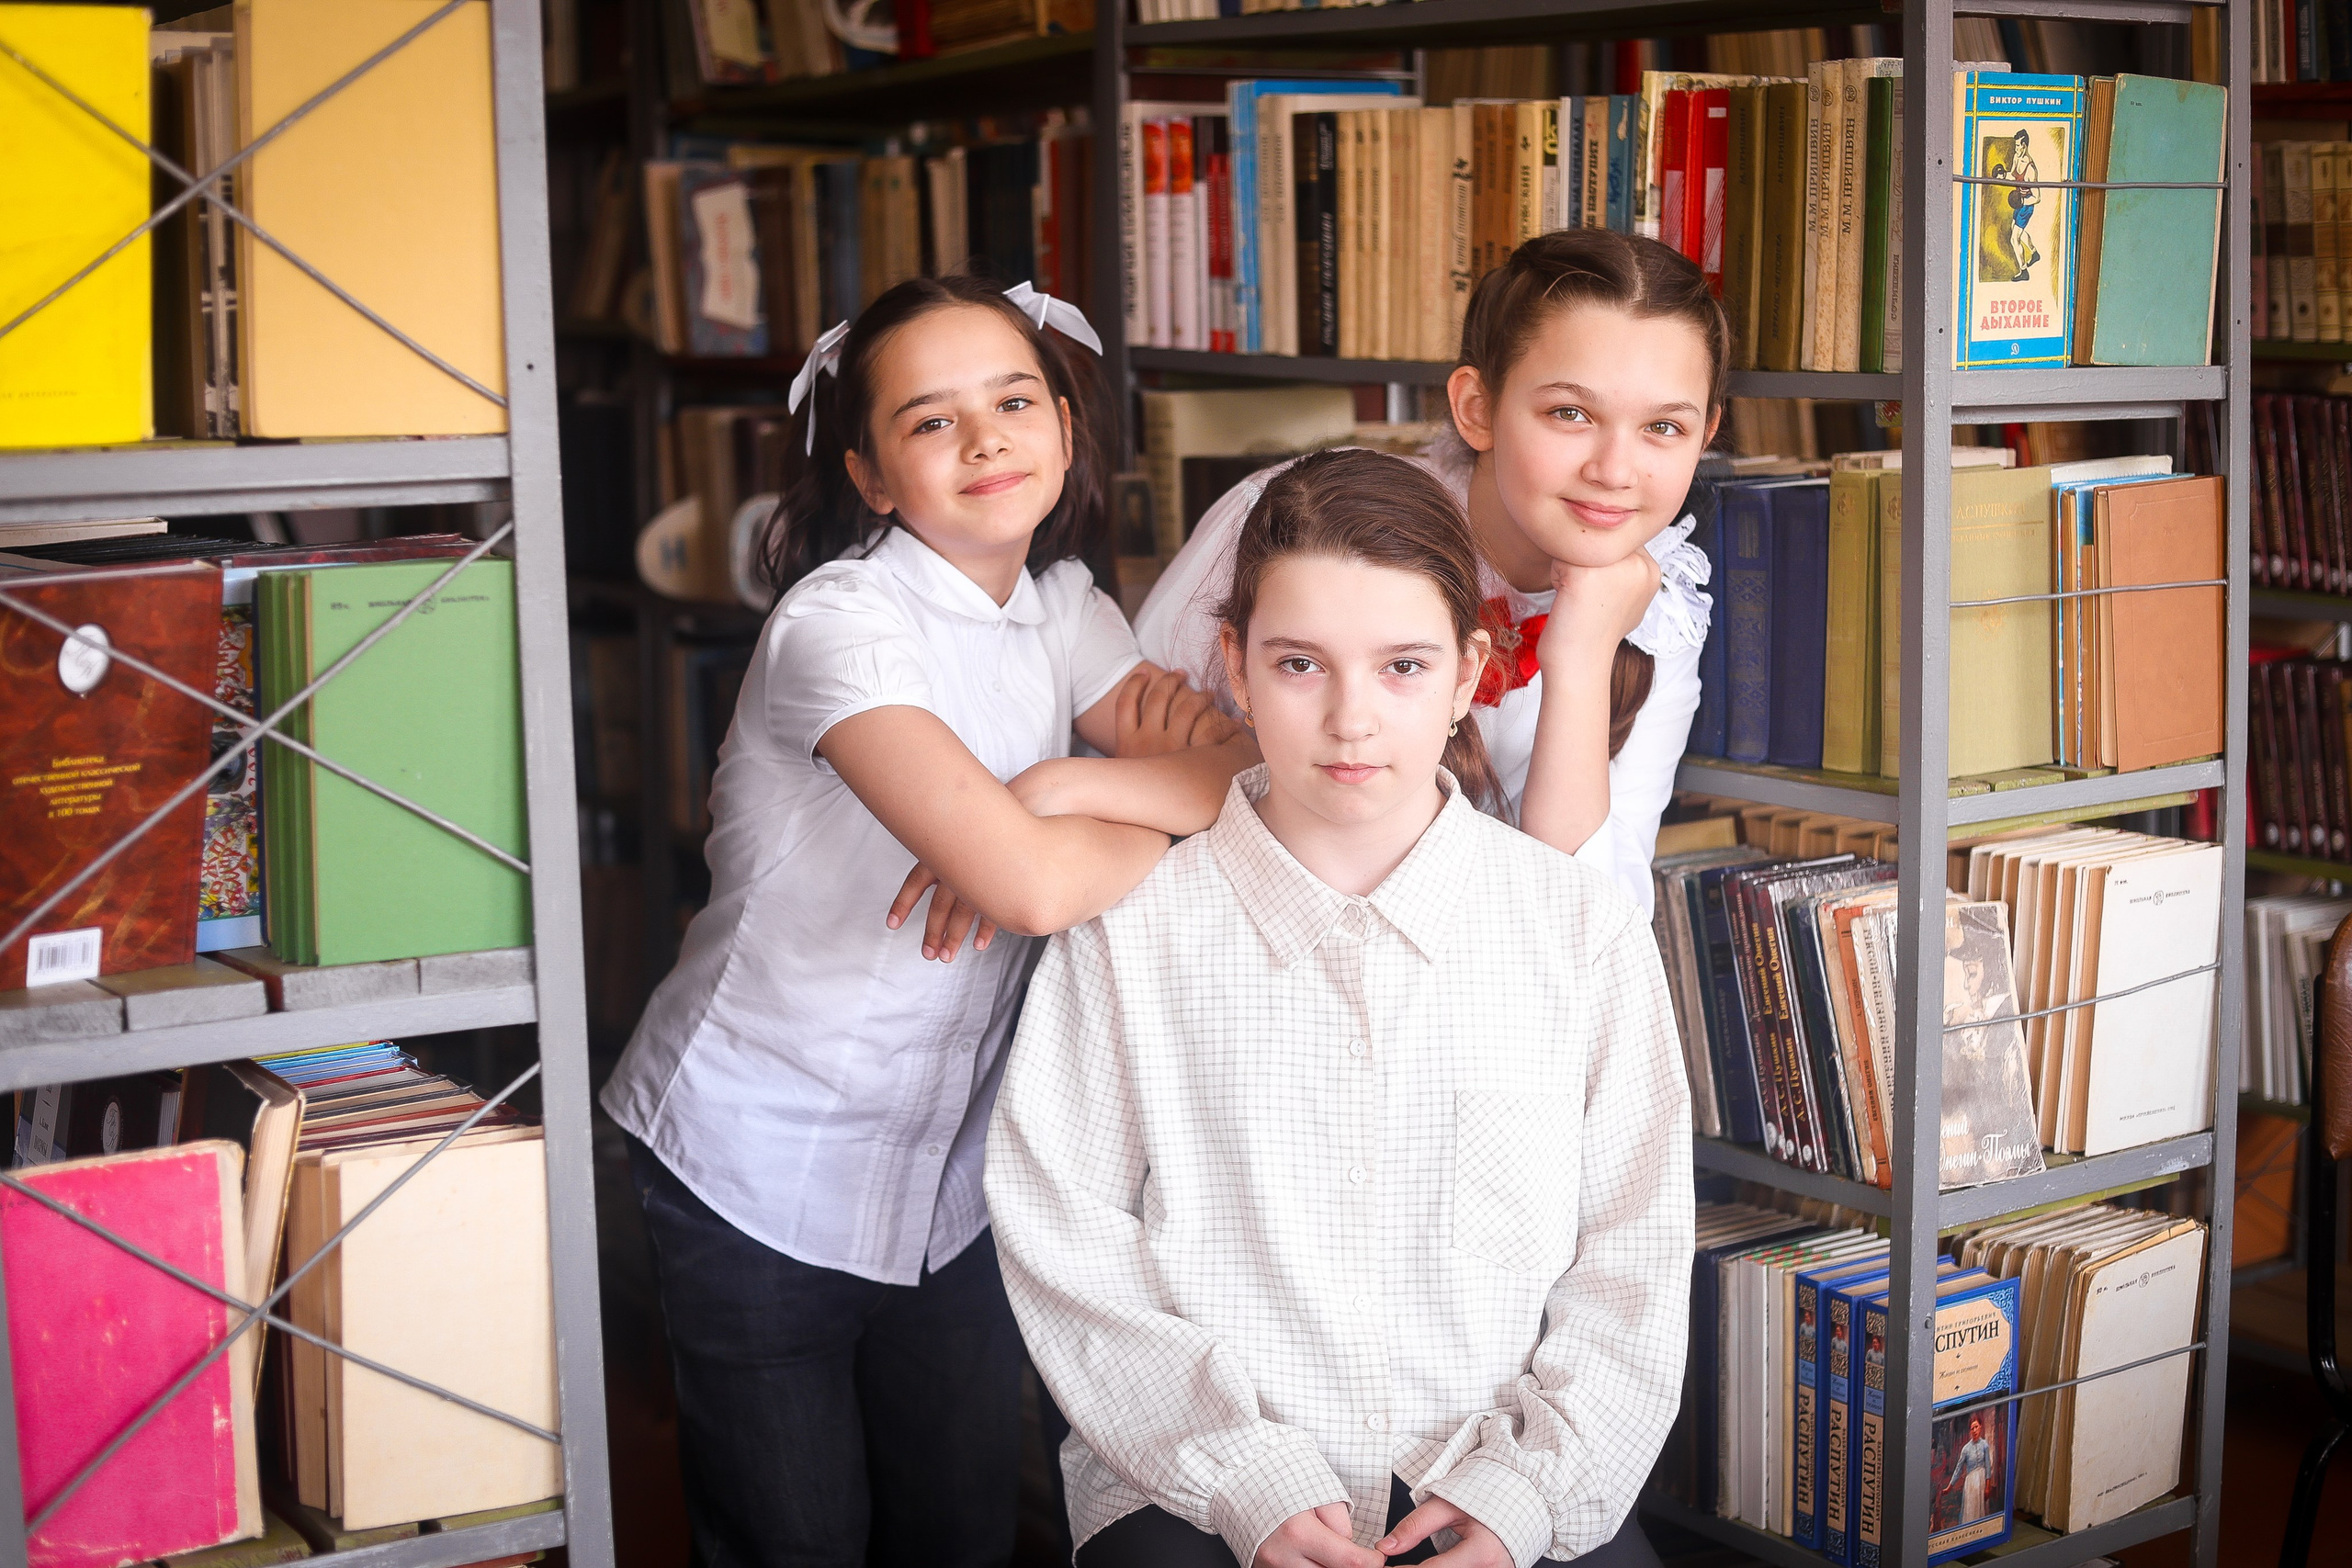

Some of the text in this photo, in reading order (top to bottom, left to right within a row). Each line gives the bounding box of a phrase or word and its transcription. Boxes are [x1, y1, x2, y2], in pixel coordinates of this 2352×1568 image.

[1989, 96, 2062, 106] ВИКТОР ПУШКИН
[1770, 233, 1784, 340] ЗЕРКАЛО ЧЕЛОВЕКА
[1990, 300, 2042, 314] ВТОРОЕ
[1981, 314, 2050, 331] ДЫХАНИЕ
[12, 763, 141, 785] отечественной классической
[52, 756, 105, 768] Библиотека
[40, 778, 114, 795] художественной
[50, 793, 102, 806] литературы
[57, 807, 74, 818] 100
[75, 806, 101, 815] томах
[1751, 922, 1773, 1016] Евгений Онегин
[1766, 926, 1789, 1021] Евгений Онегин
[1770, 1032, 1783, 1083] Пушкин
[1785, 1037, 1800, 1088] Пушкин
[1940, 1113, 1970, 1139] ений
[1935, 1320, 1999, 1352] СПУТИН
[1799, 1393, 1811, 1505] РАСПУТИН
[1829, 1409, 1842, 1521] РАСПУТИН
[1861, 1421, 1877, 1535] РАСПУТИН
